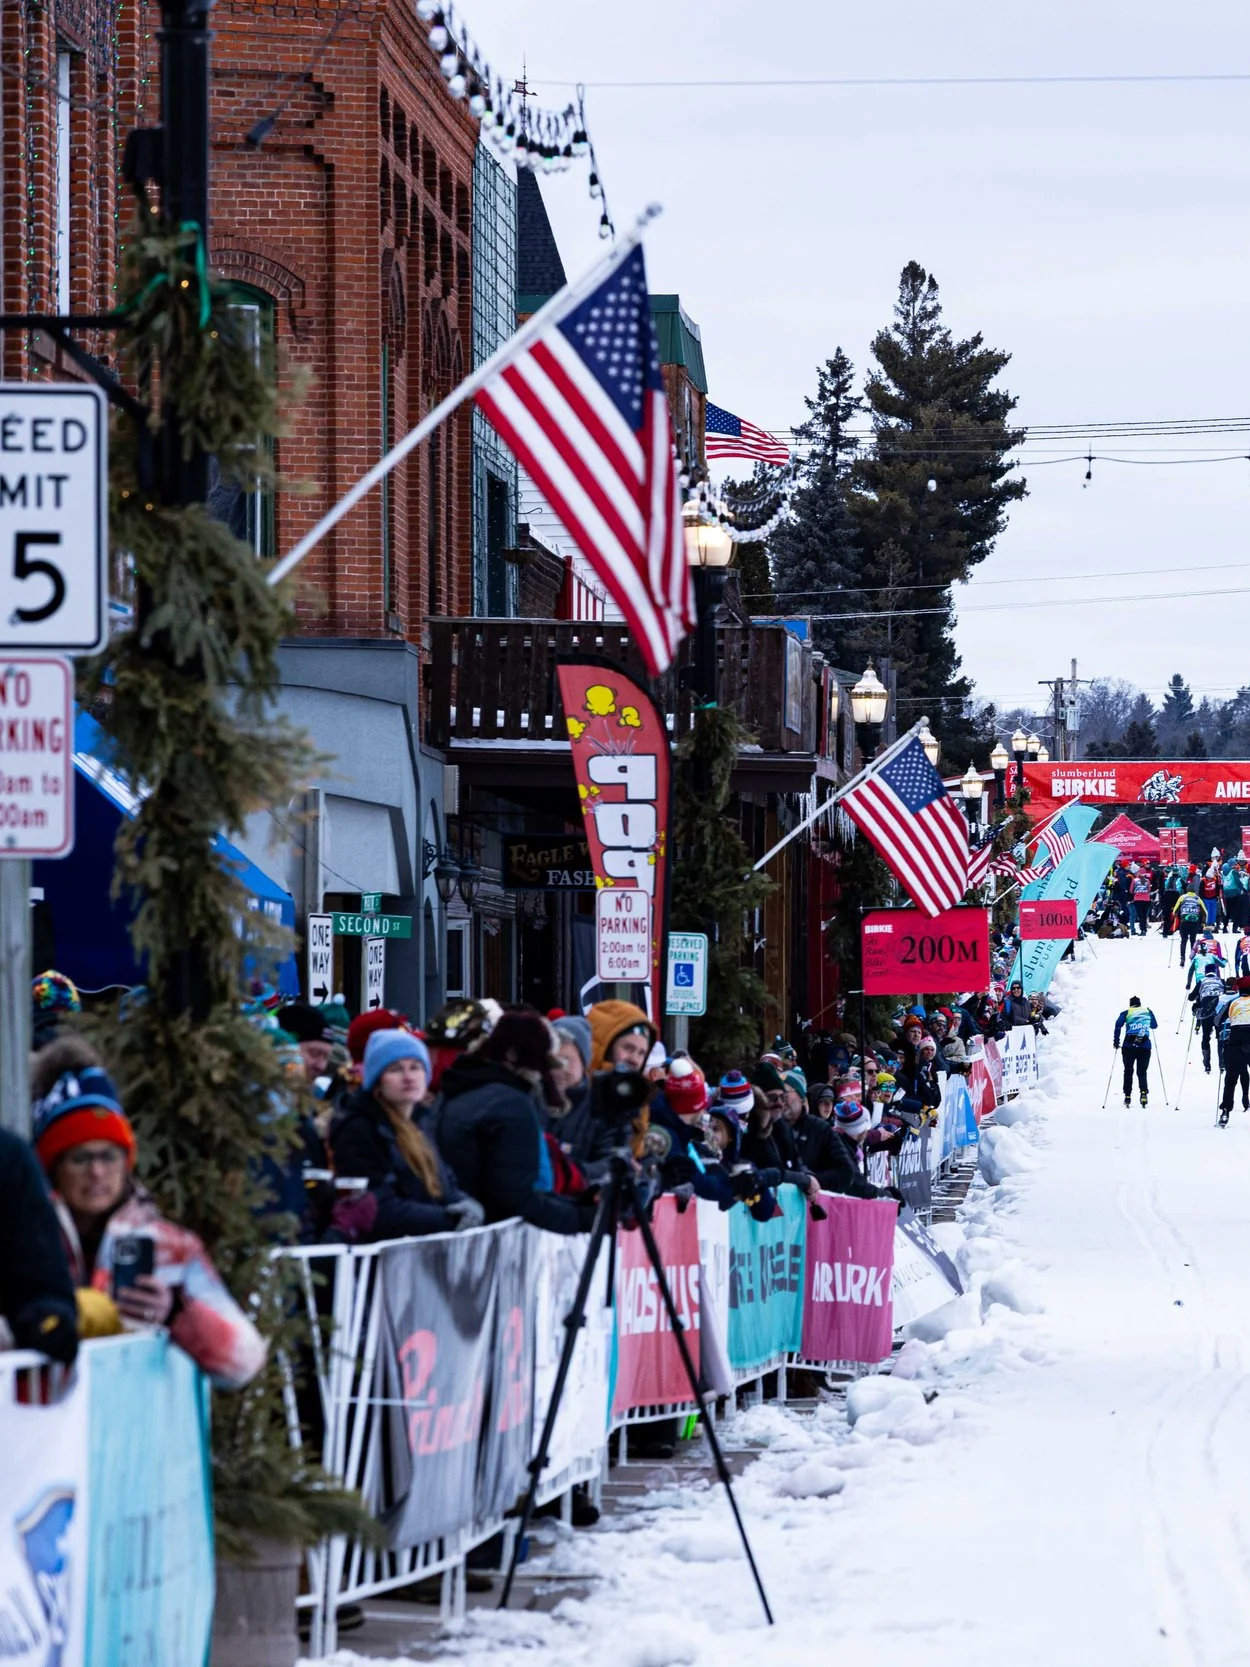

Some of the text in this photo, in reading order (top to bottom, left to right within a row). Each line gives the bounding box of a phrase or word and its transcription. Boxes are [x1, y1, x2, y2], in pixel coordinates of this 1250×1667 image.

[0, 718, 63, 754] KING
[1051, 768, 1116, 777] slumberland
[1051, 778, 1117, 798] BIRKIE
[613, 896, 633, 913] NO
[338, 915, 390, 934] SECOND
[600, 917, 647, 934] PARKING
[1039, 912, 1074, 927] 100M
[311, 924, 331, 948] ONE
[368, 945, 383, 965] ONE
[601, 941, 646, 953] 2:00am to
[900, 935, 980, 964] 200M
[311, 951, 330, 975] WAY
[608, 957, 640, 968] 6:00am
[368, 968, 383, 988] WAY
